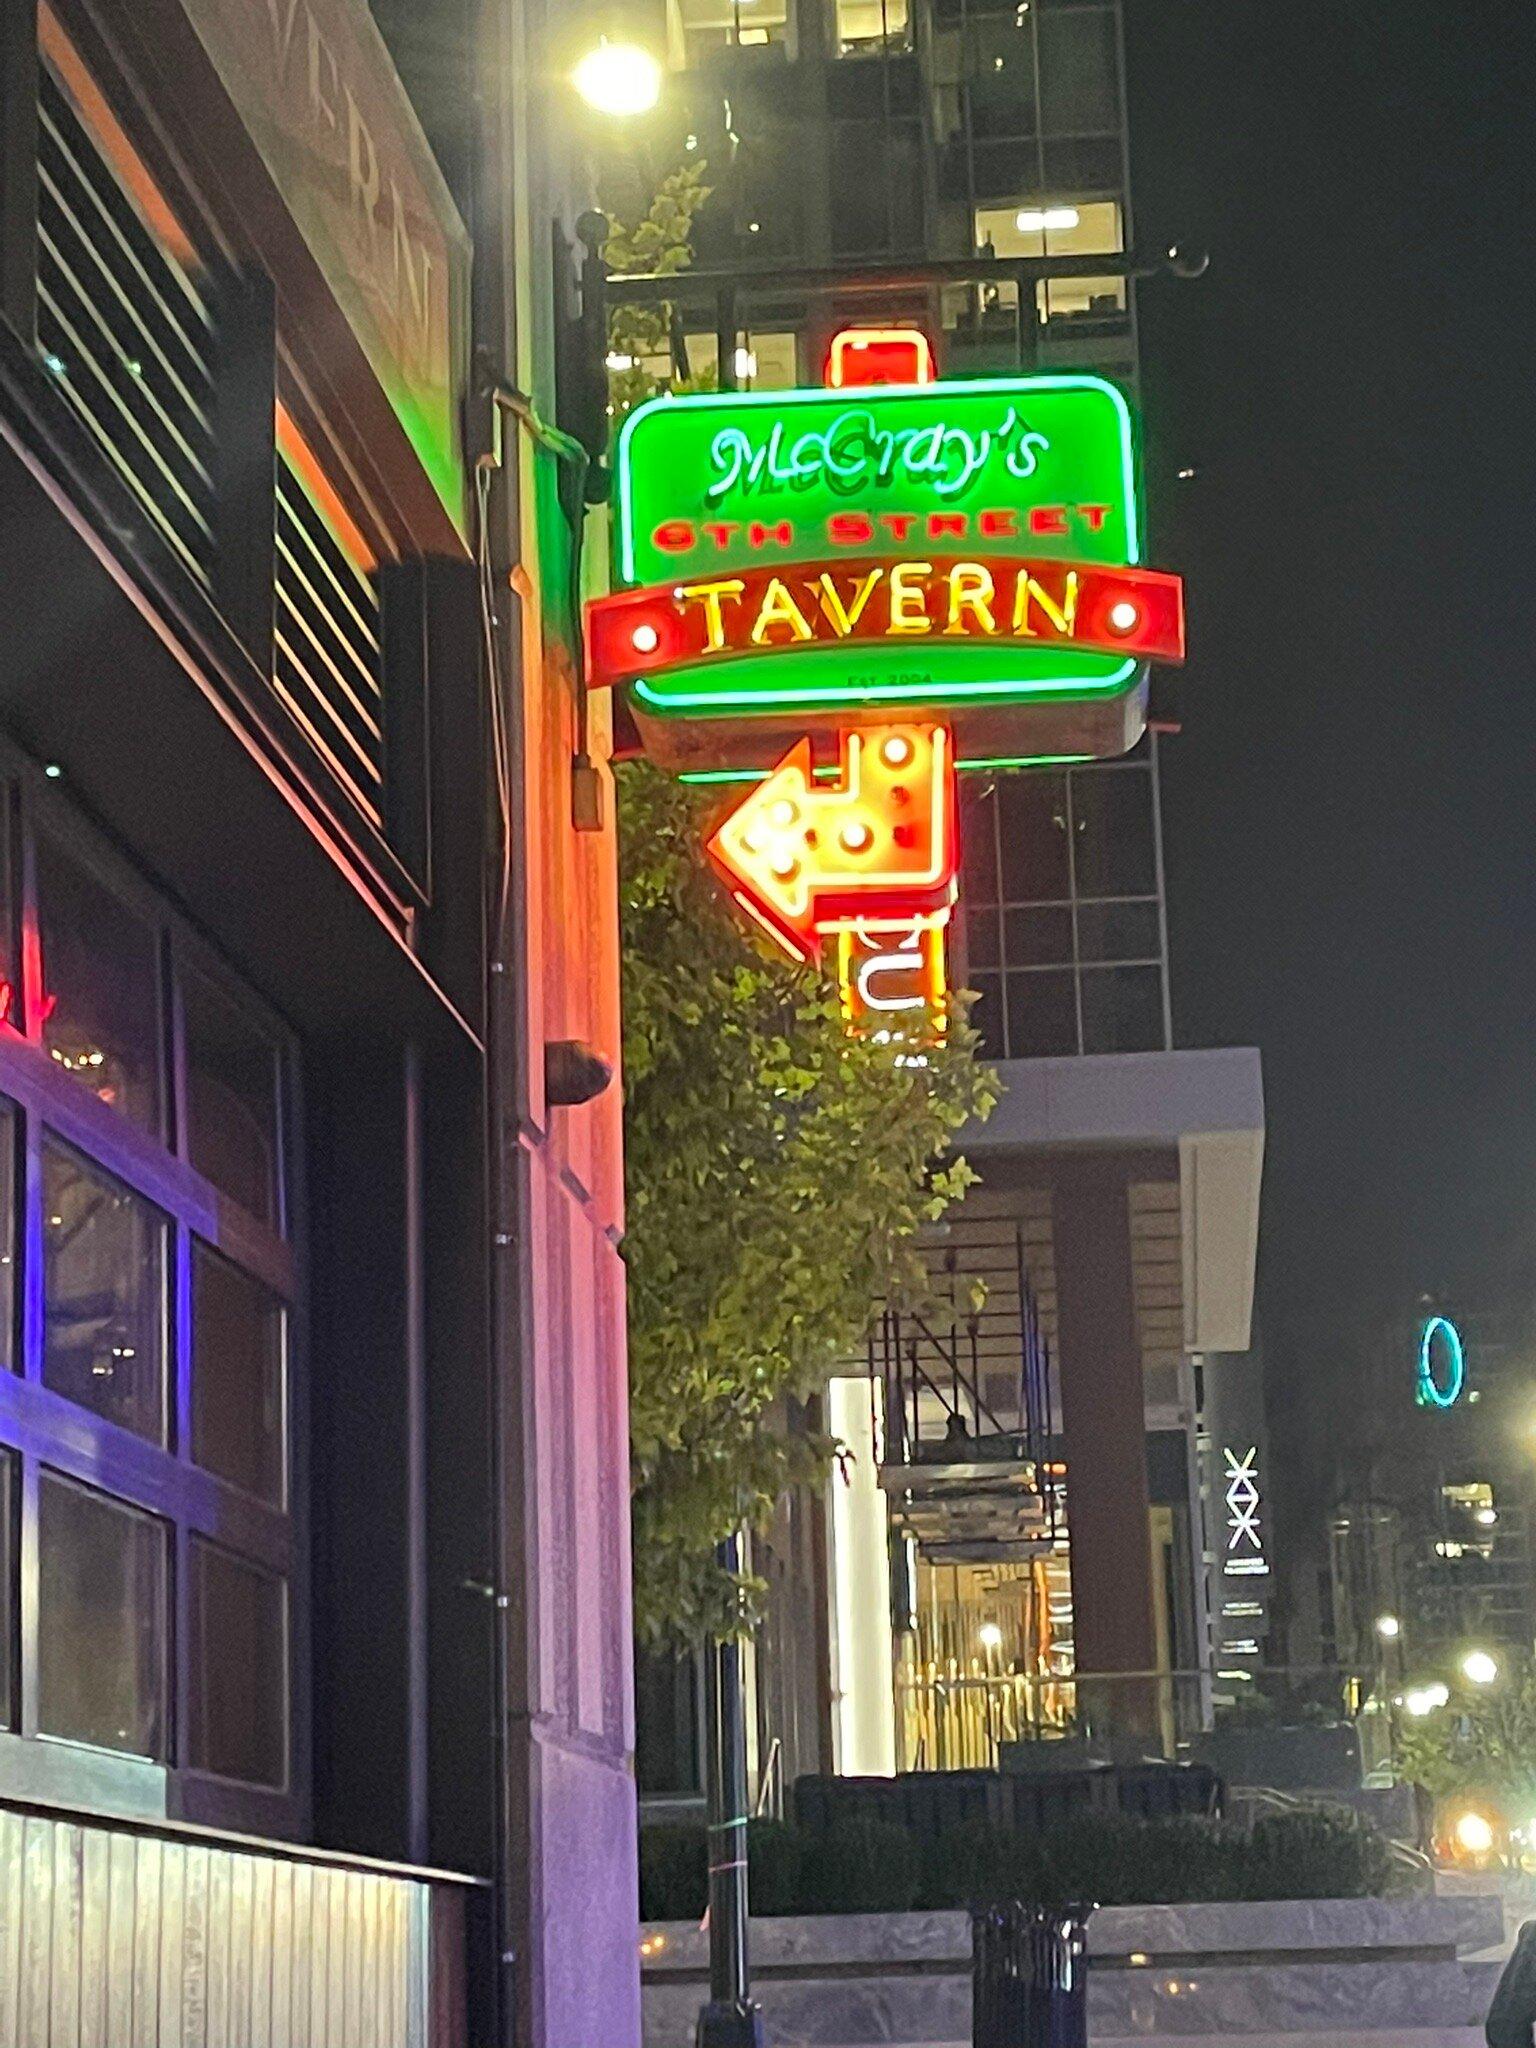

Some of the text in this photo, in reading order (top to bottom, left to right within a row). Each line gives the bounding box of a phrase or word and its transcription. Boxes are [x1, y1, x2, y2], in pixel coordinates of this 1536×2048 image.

[708, 407, 1050, 496] McCray's
[826, 504, 1112, 545] STREET
[674, 561, 1079, 654] TAVERN
